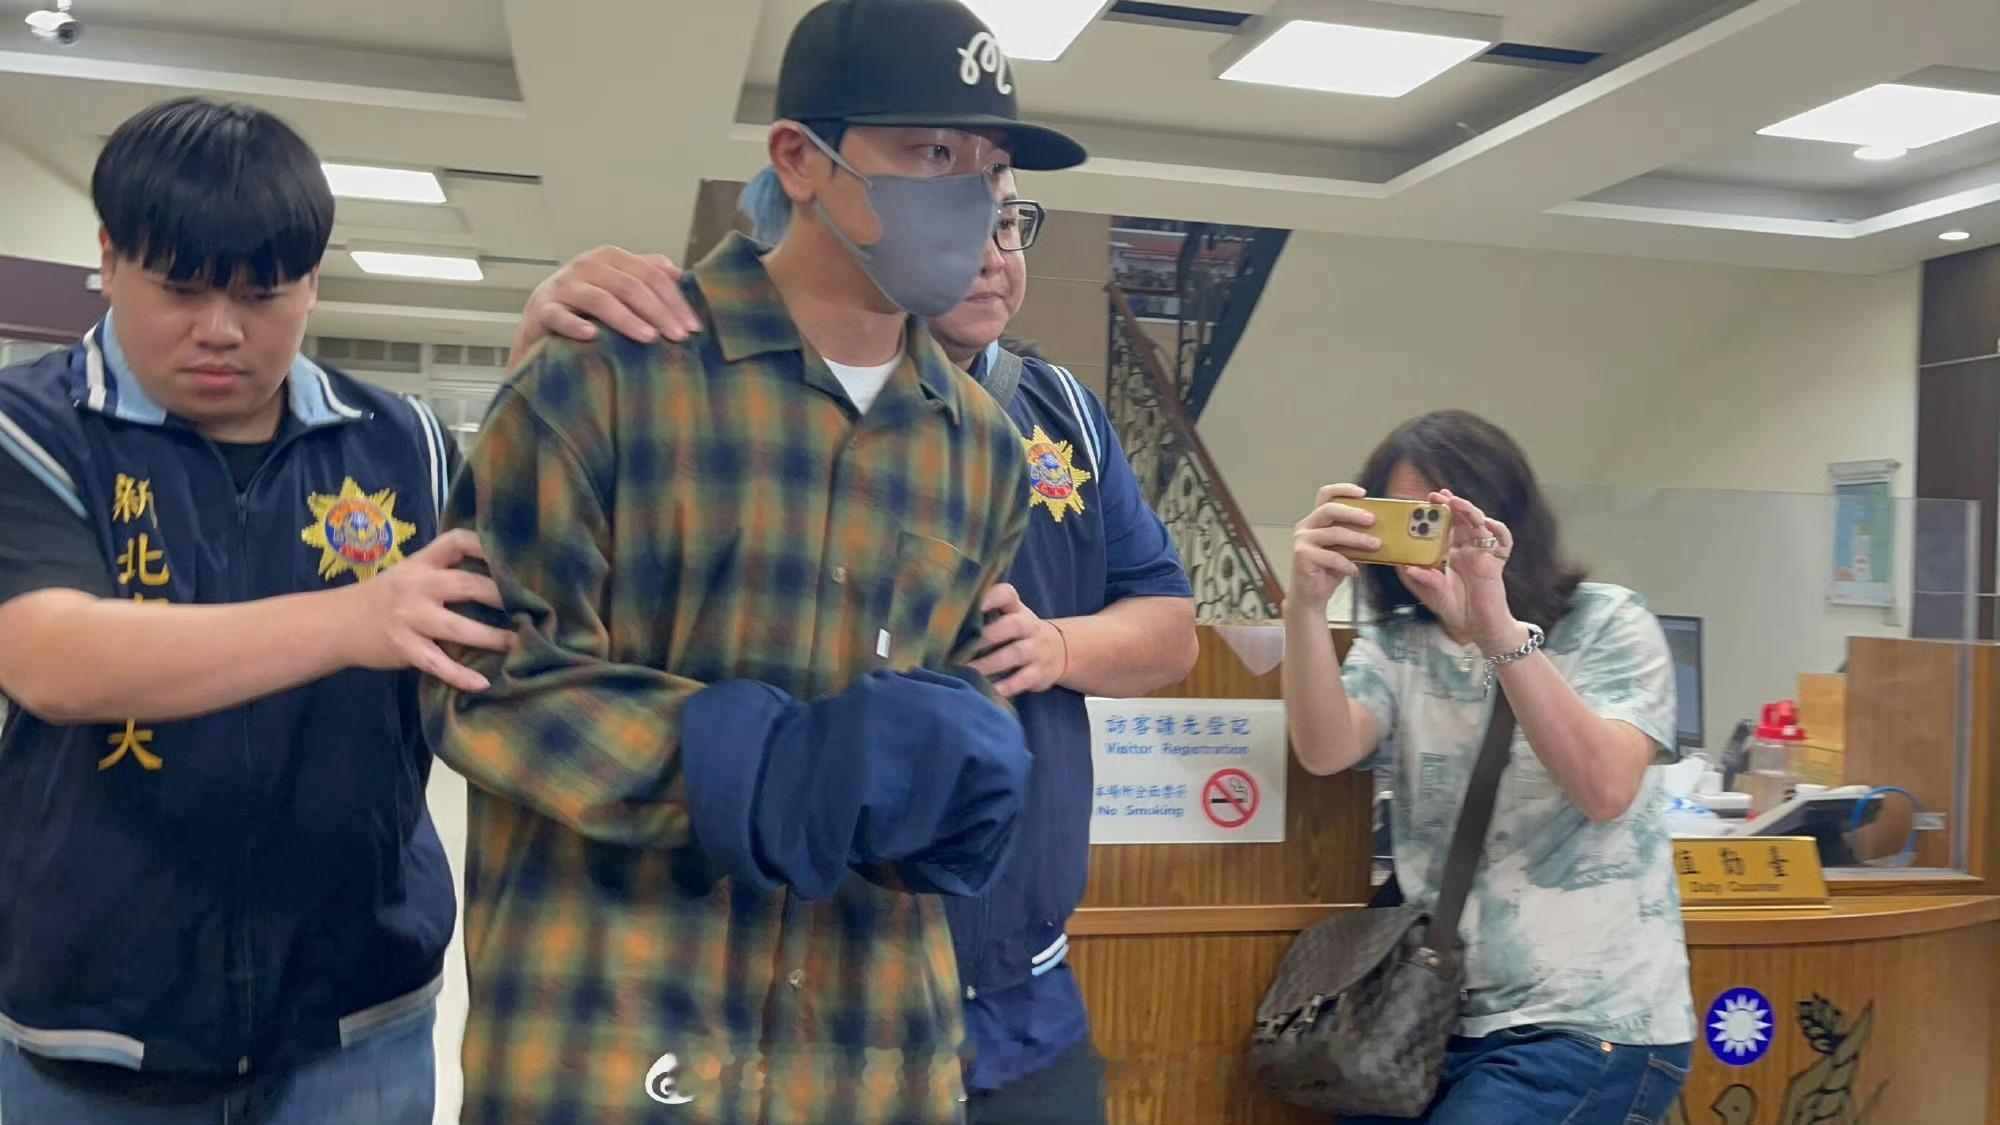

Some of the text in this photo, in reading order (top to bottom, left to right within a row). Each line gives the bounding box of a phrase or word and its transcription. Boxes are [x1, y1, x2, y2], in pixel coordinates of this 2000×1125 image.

[1104, 713, 1251, 736] 訪客請先登記
[1106, 741, 1250, 757] Visitor Registration
[1097, 804, 1185, 818] No Smoking
